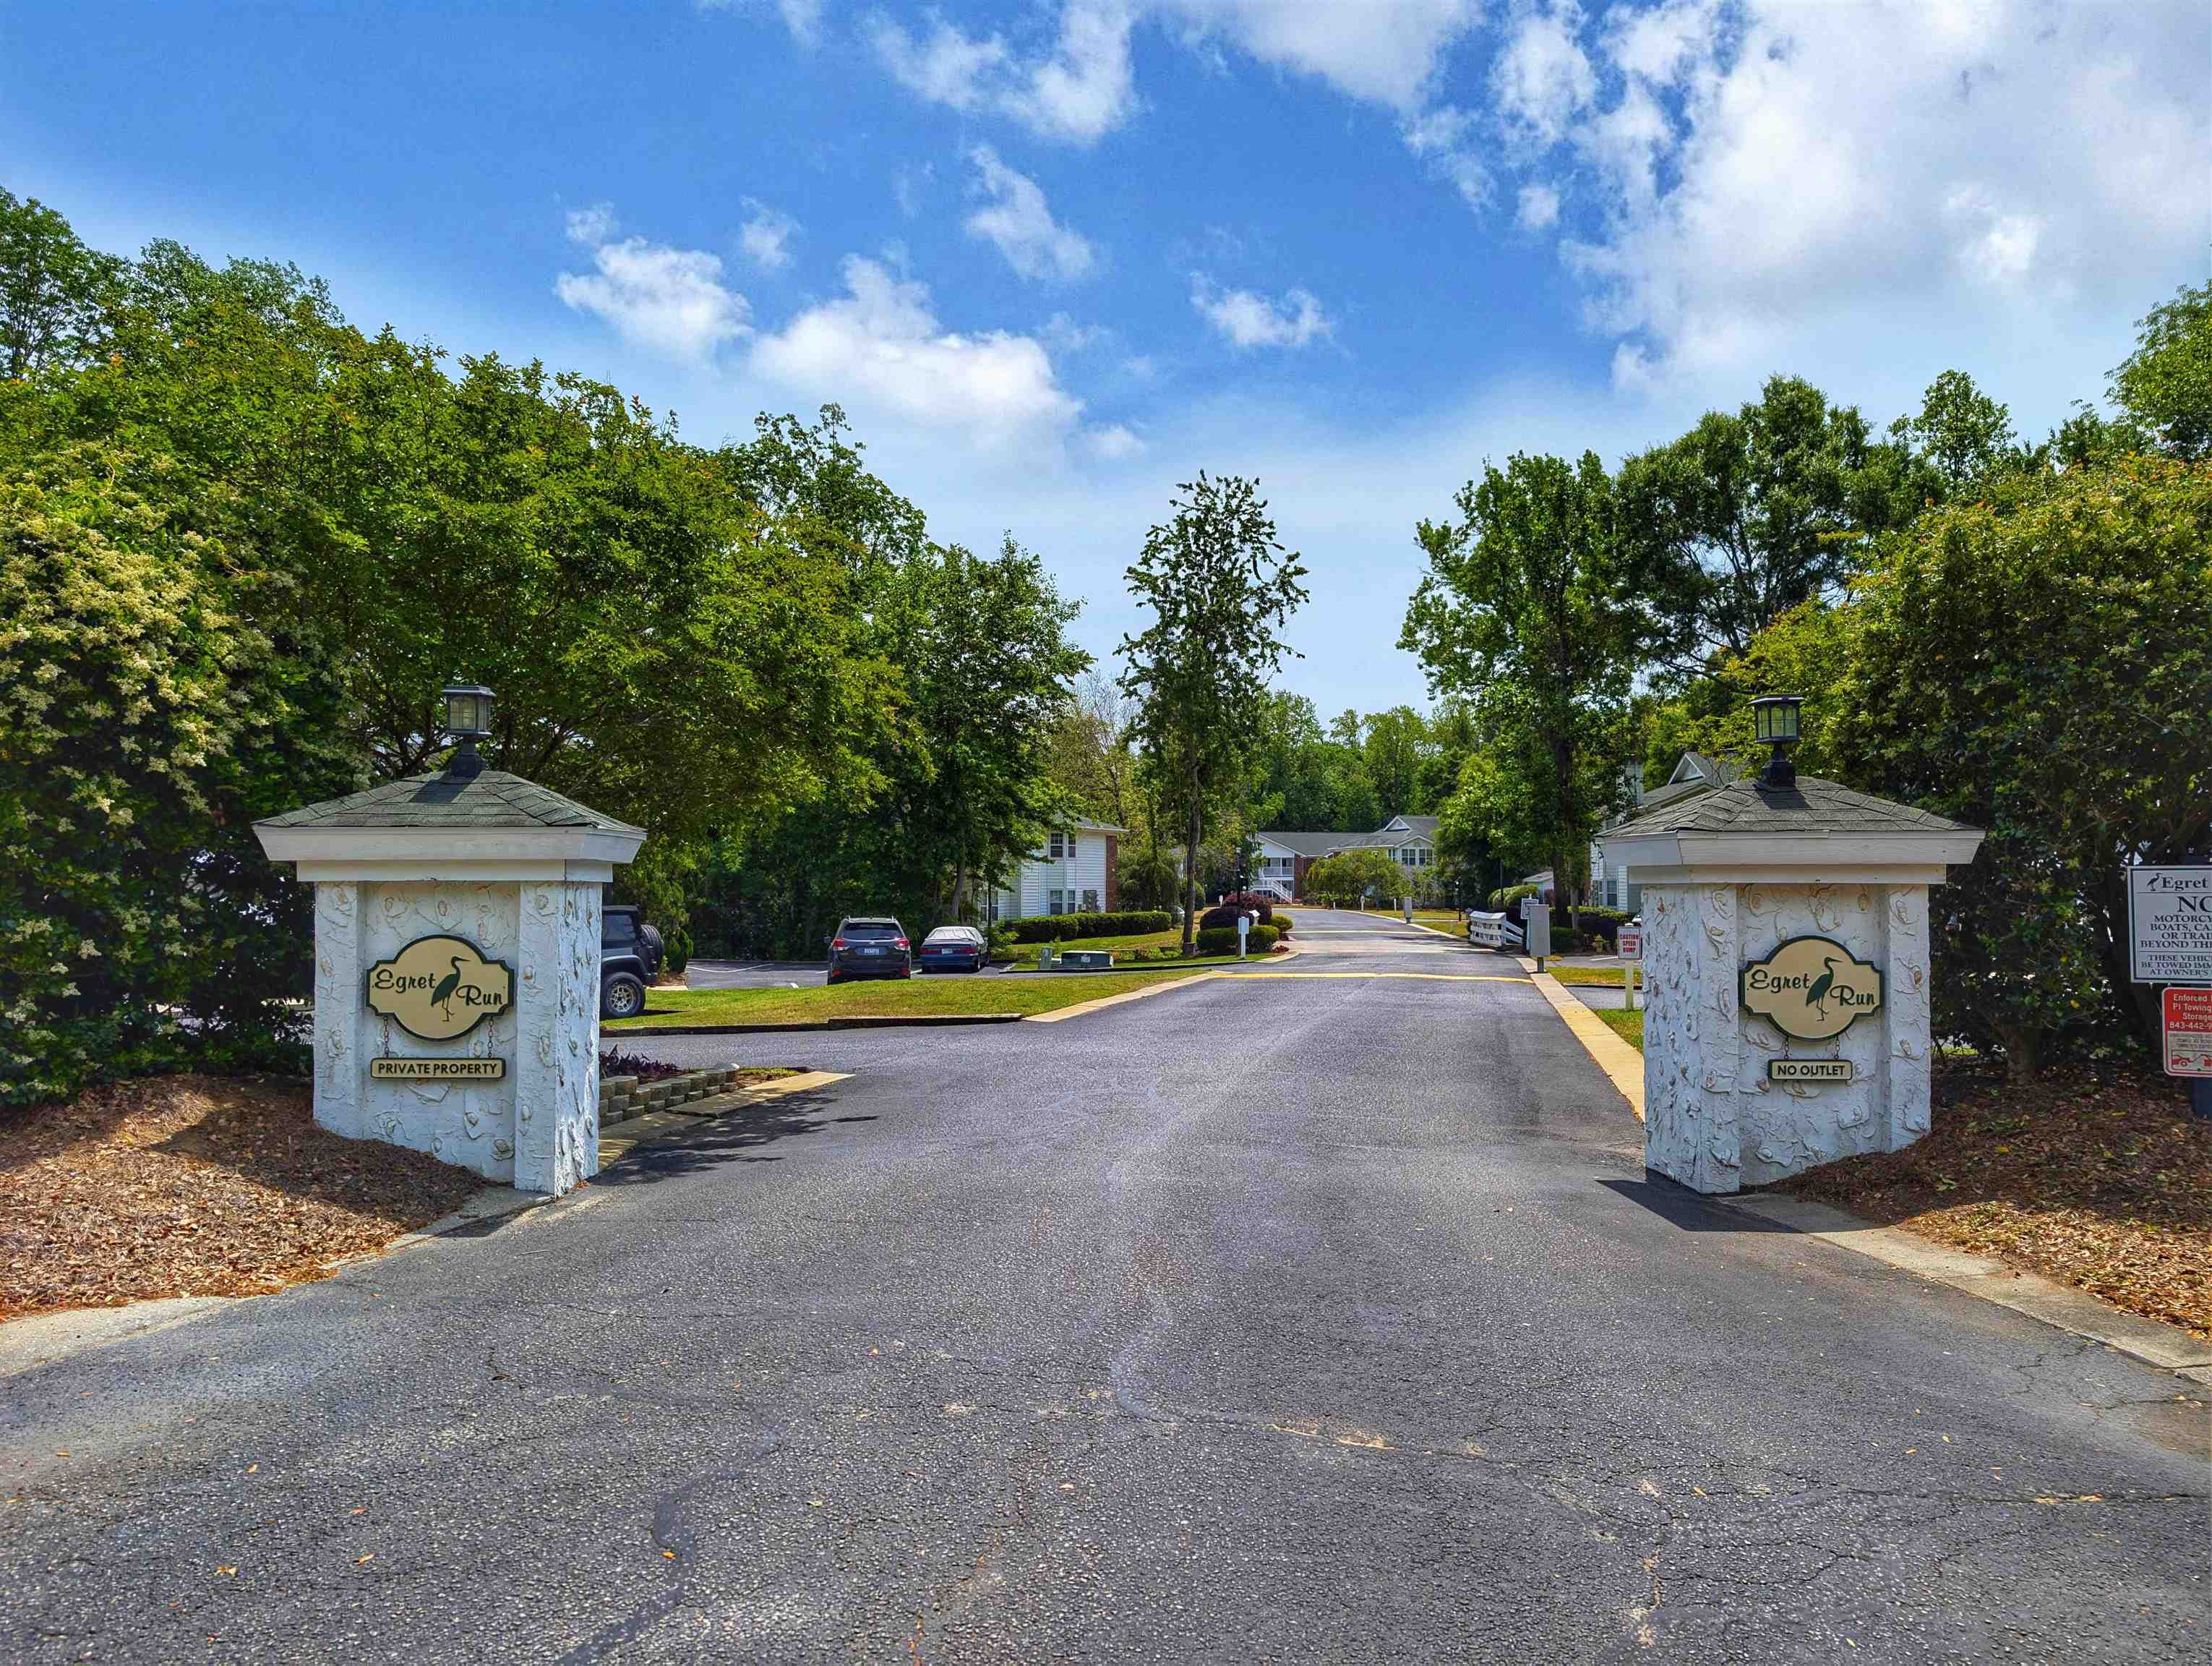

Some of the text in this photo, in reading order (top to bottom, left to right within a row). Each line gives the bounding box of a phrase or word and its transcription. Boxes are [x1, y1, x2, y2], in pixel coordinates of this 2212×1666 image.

[2162, 876, 2208, 892] Egret
[2151, 923, 2191, 932] BOATS,
[375, 969, 503, 1006] Egret Run
[1749, 969, 1875, 1006] Egret Run
[378, 1064, 497, 1075] PRIVATE PROPERTY
[1778, 1065, 1845, 1075] NO OUTLET
